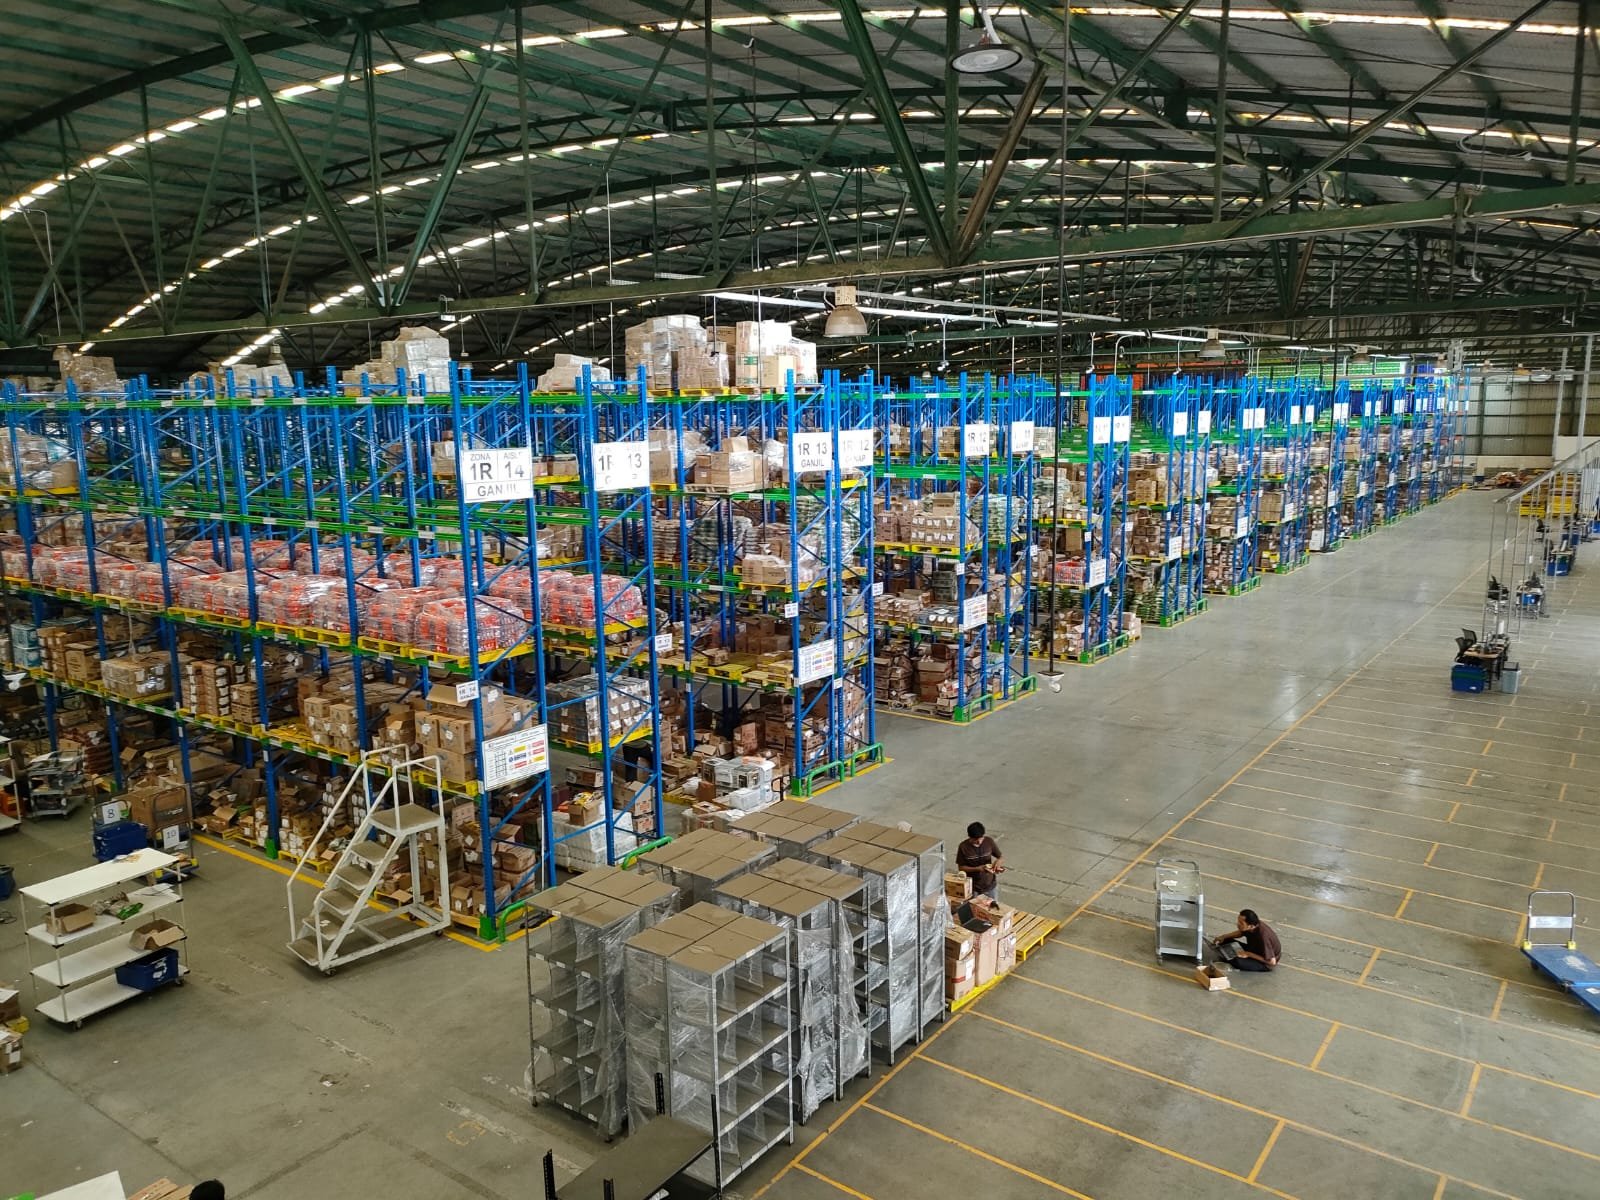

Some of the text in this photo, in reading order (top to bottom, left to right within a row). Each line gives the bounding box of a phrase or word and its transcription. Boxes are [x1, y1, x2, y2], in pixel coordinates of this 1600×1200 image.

[797, 442, 828, 456] 1R 13
[470, 453, 491, 461] ZONA
[627, 452, 642, 469] 13
[801, 459, 825, 468] GANJIL
[470, 461, 525, 481] 1R 14
[166, 831, 177, 839] 10
